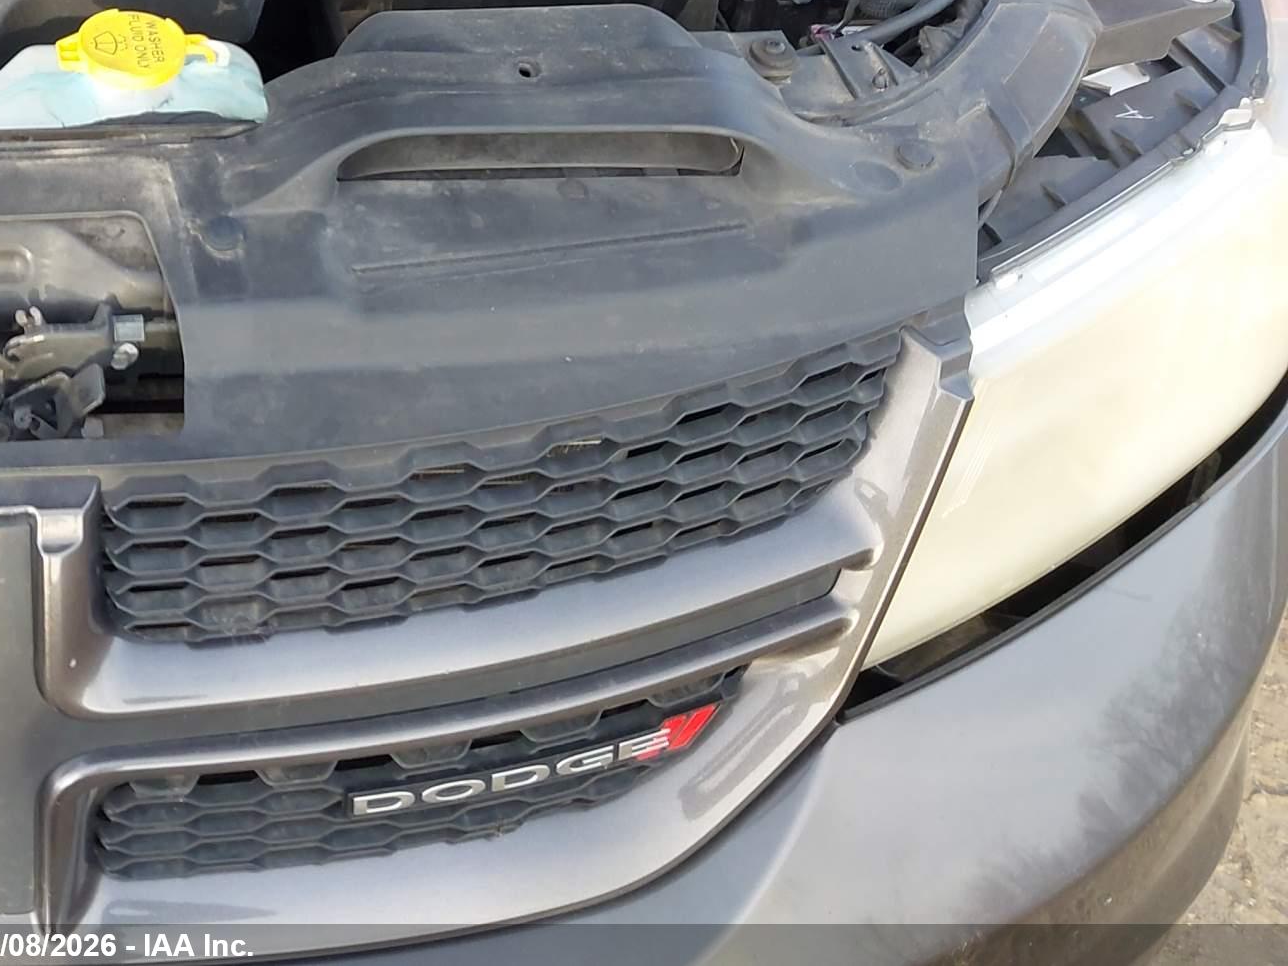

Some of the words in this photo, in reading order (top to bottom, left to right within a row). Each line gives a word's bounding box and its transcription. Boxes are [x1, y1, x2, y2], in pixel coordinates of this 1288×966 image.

[128, 13, 144, 42] FLUID
[145, 20, 165, 64] WASHER
[134, 45, 152, 70] ONLY
[352, 727, 671, 816] DODGE
